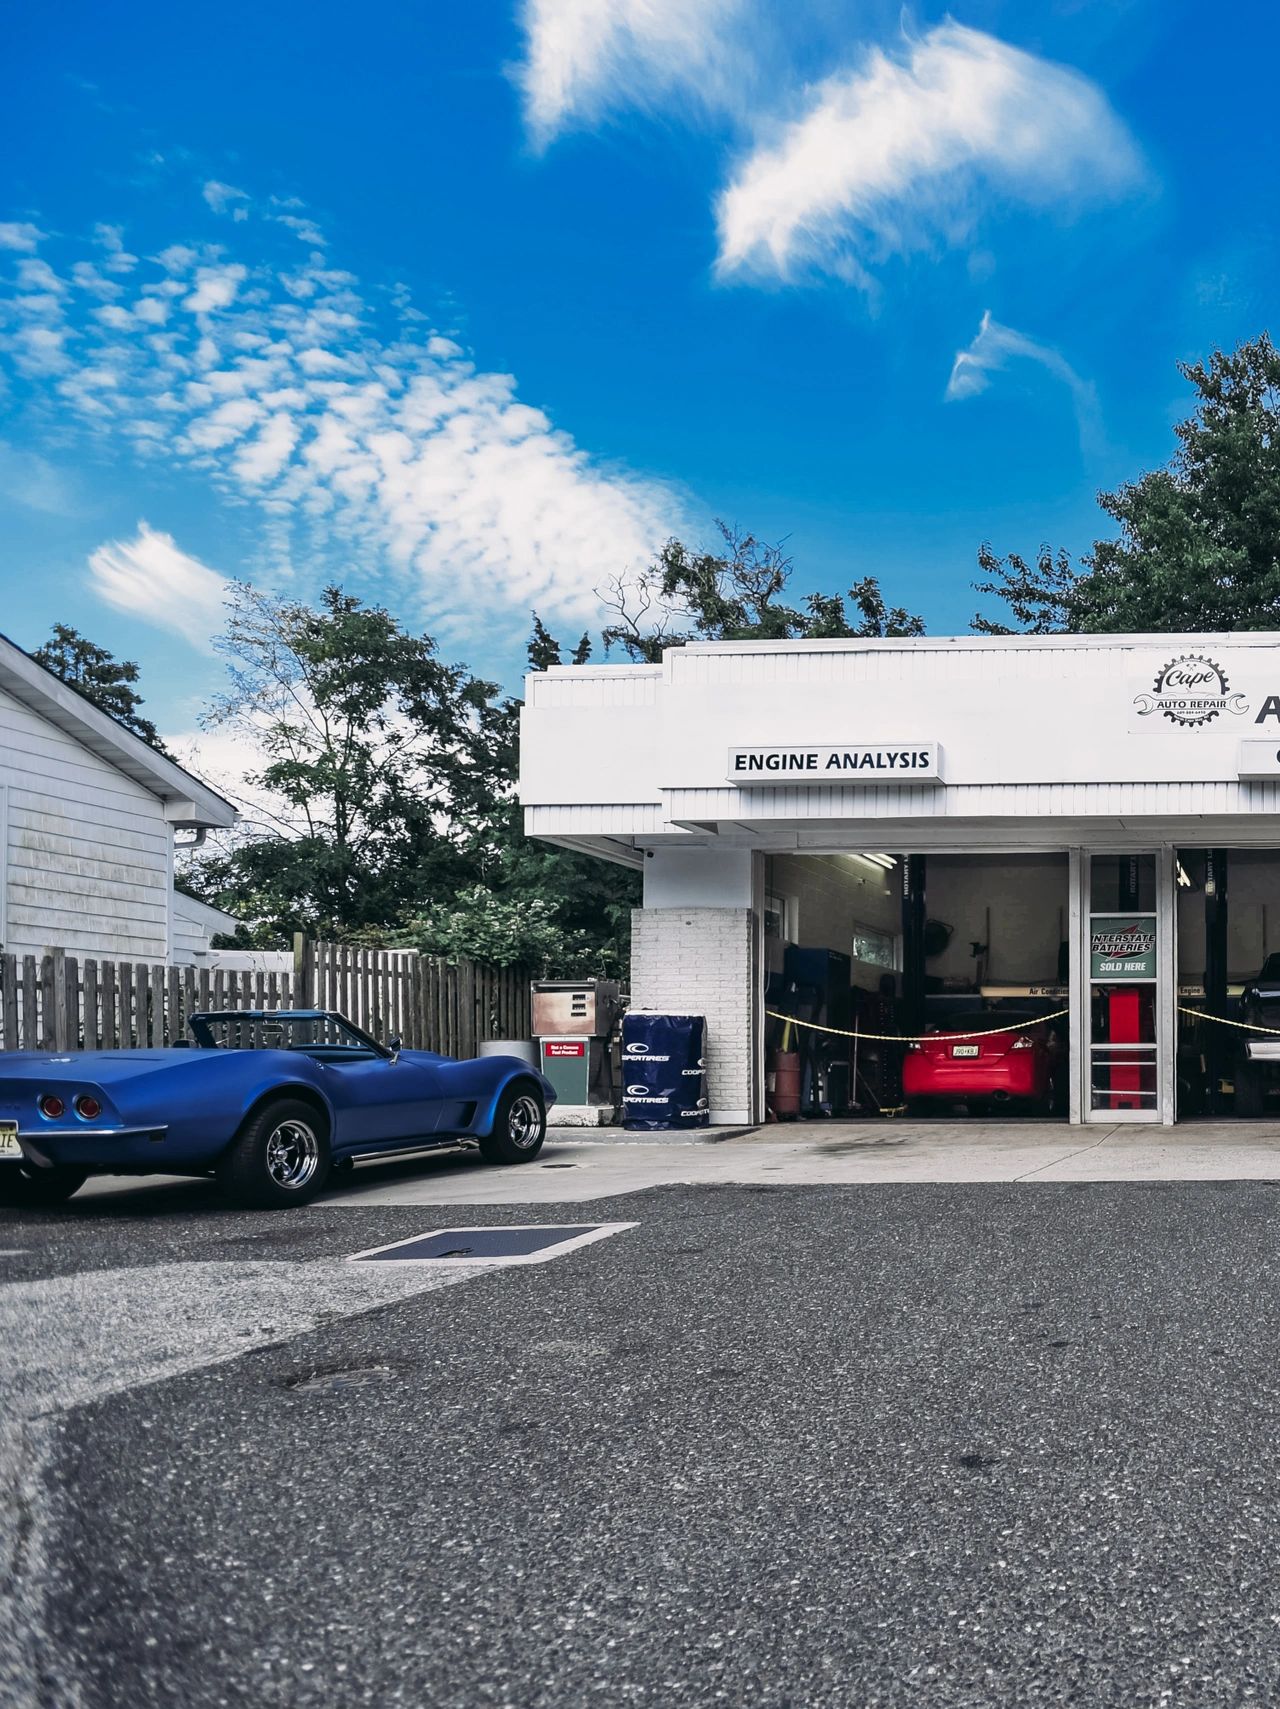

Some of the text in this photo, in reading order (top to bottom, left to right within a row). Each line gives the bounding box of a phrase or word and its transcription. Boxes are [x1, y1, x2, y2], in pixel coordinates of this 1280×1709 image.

[1165, 670, 1214, 688] Cape
[1157, 700, 1227, 709] AUTO REPAIR
[734, 751, 930, 771] ENGINE ANALYSIS
[1091, 934, 1156, 944] INTERSTATE
[1092, 943, 1151, 952] BATTERIES
[1099, 962, 1147, 971] SOLD HERE
[1180, 987, 1201, 996] Engine
